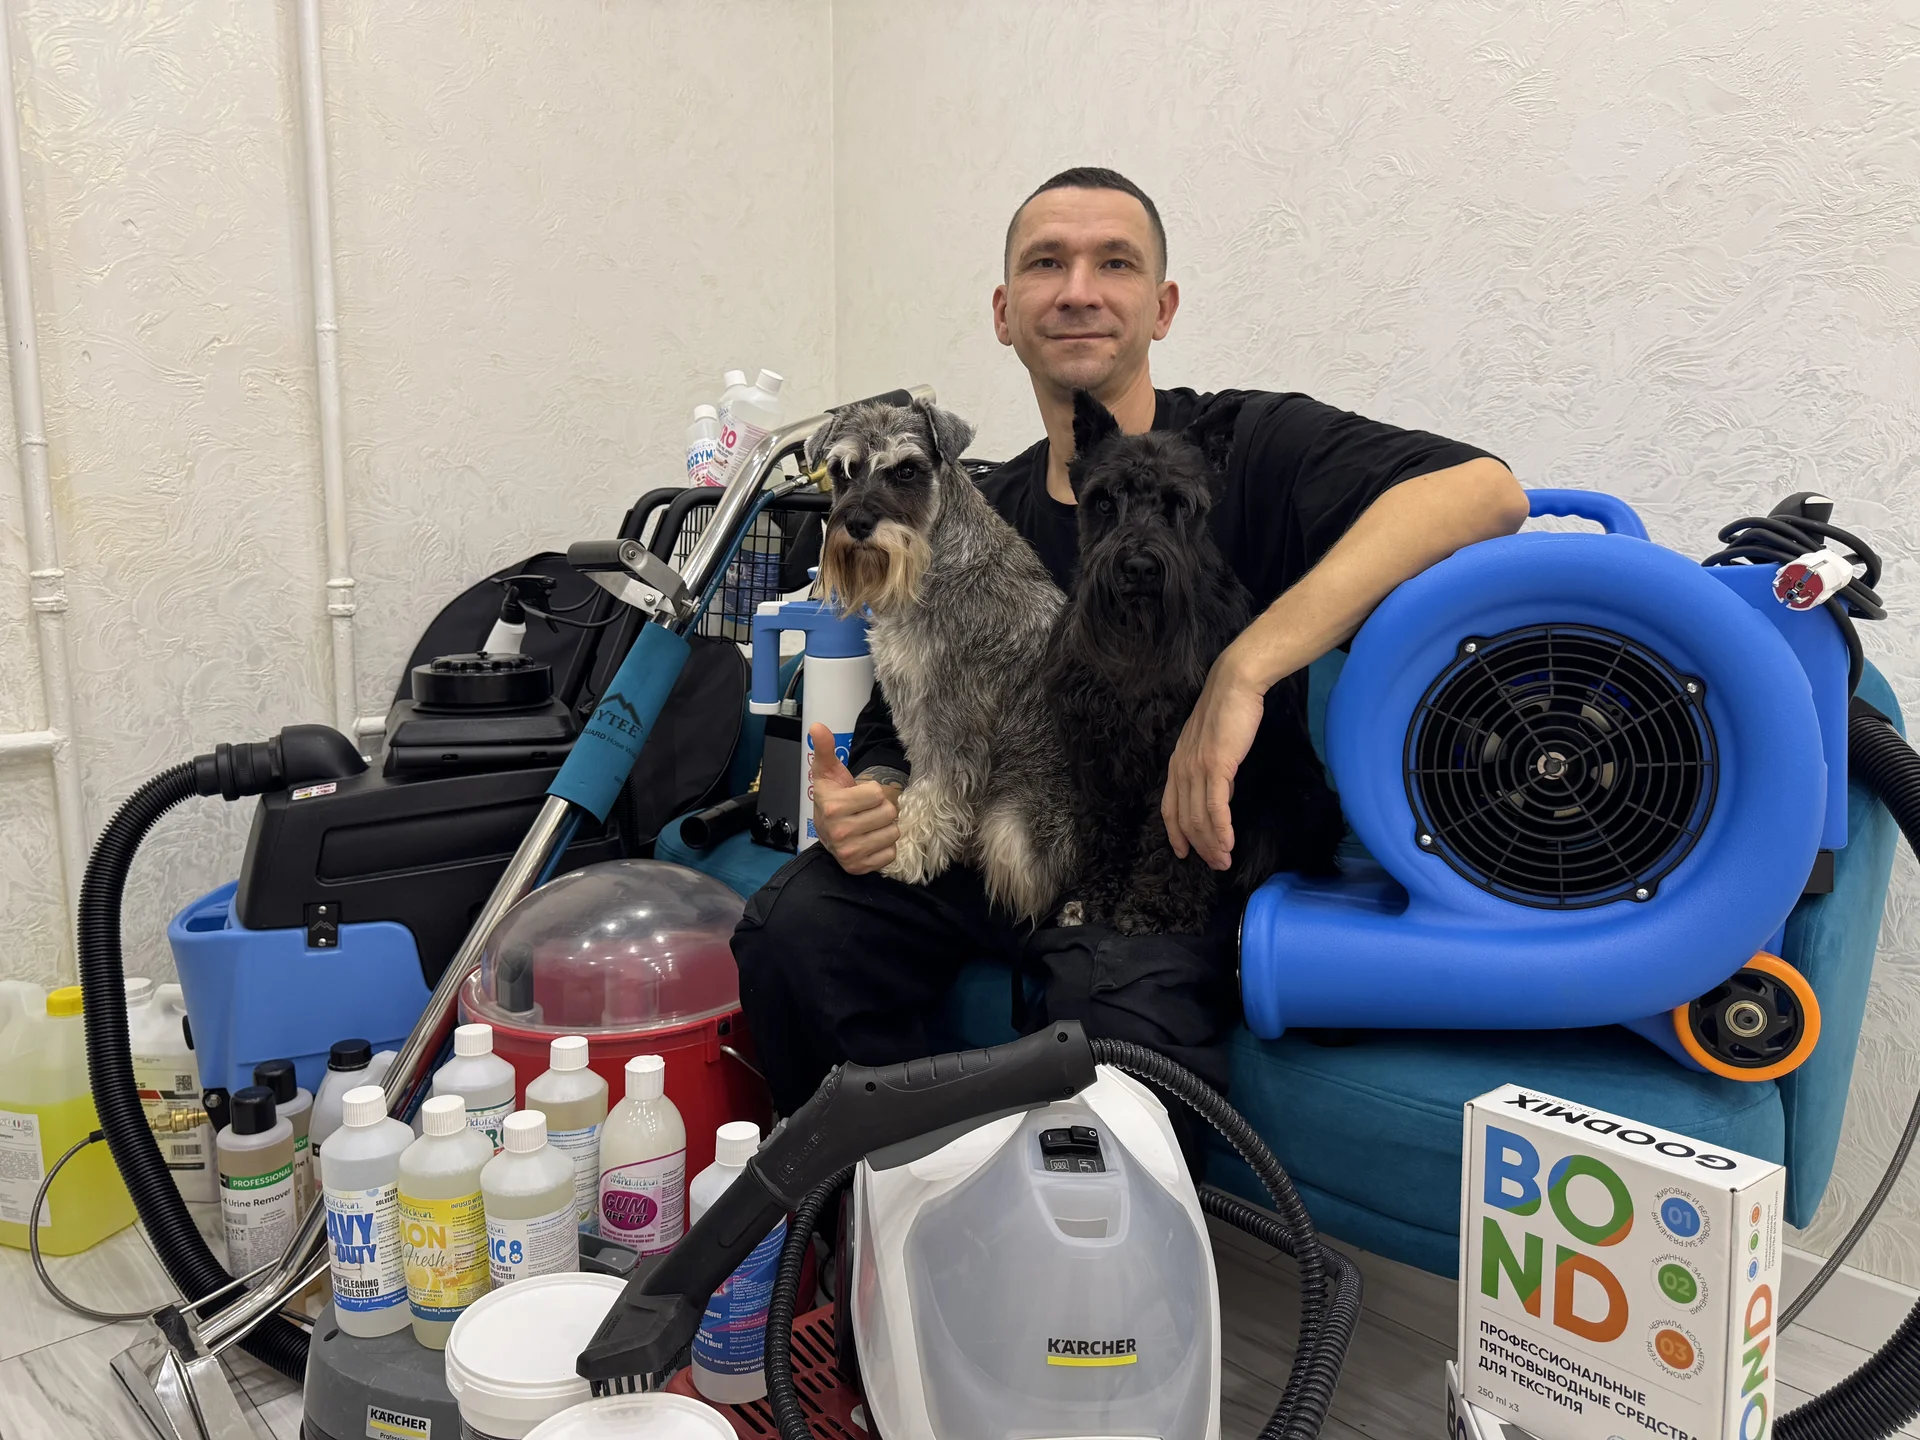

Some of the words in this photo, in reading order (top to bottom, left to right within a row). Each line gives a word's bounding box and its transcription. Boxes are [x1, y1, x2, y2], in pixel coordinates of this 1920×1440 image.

[583, 728, 607, 740] UARD
[592, 709, 639, 739] YTEE
[1503, 1094, 1737, 1171] GOODMIX
[233, 1167, 291, 1187] PROFESSIONAL
[229, 1199, 251, 1207] Urine
[253, 1188, 291, 1206] Remover
[605, 1193, 649, 1214] GUM
[1654, 1187, 1692, 1200] ЖИРОВЫЕ
[627, 1213, 648, 1225] IT!
[1668, 1206, 1692, 1229] 01
[337, 1244, 376, 1264] DUTY
[402, 1243, 445, 1267] Fresh
[509, 1240, 523, 1264] 8
[338, 1285, 379, 1297] UPHOLSTERY
[343, 1279, 379, 1288] CLEANING
[1651, 1253, 1692, 1268] ТАНИННЫЕ
[1688, 1267, 1709, 1316] ЗАГРЯЗНЕНИЯ
[1663, 1271, 1690, 1297] 02
[1047, 1337, 1137, 1355] KÄRCHER
[1660, 1337, 1687, 1361] 03
[1480, 1319, 1646, 1406] ПРОФЕССИОНАЛЬНЫЕ
[1478, 1355, 1507, 1378] ДЛЯ
[1511, 1369, 1583, 1415] ТЕКСТИЛЯ
[1479, 1337, 1611, 1410] ПЯТНОВЫВОДНЫЕ
[1615, 1401, 1699, 1440] СРЕДСТВ
[1477, 1385, 1494, 1400] 250
[1496, 1396, 1507, 1406] ml
[1508, 1402, 1520, 1413] x3
[370, 1408, 427, 1431] KÄRCHER
